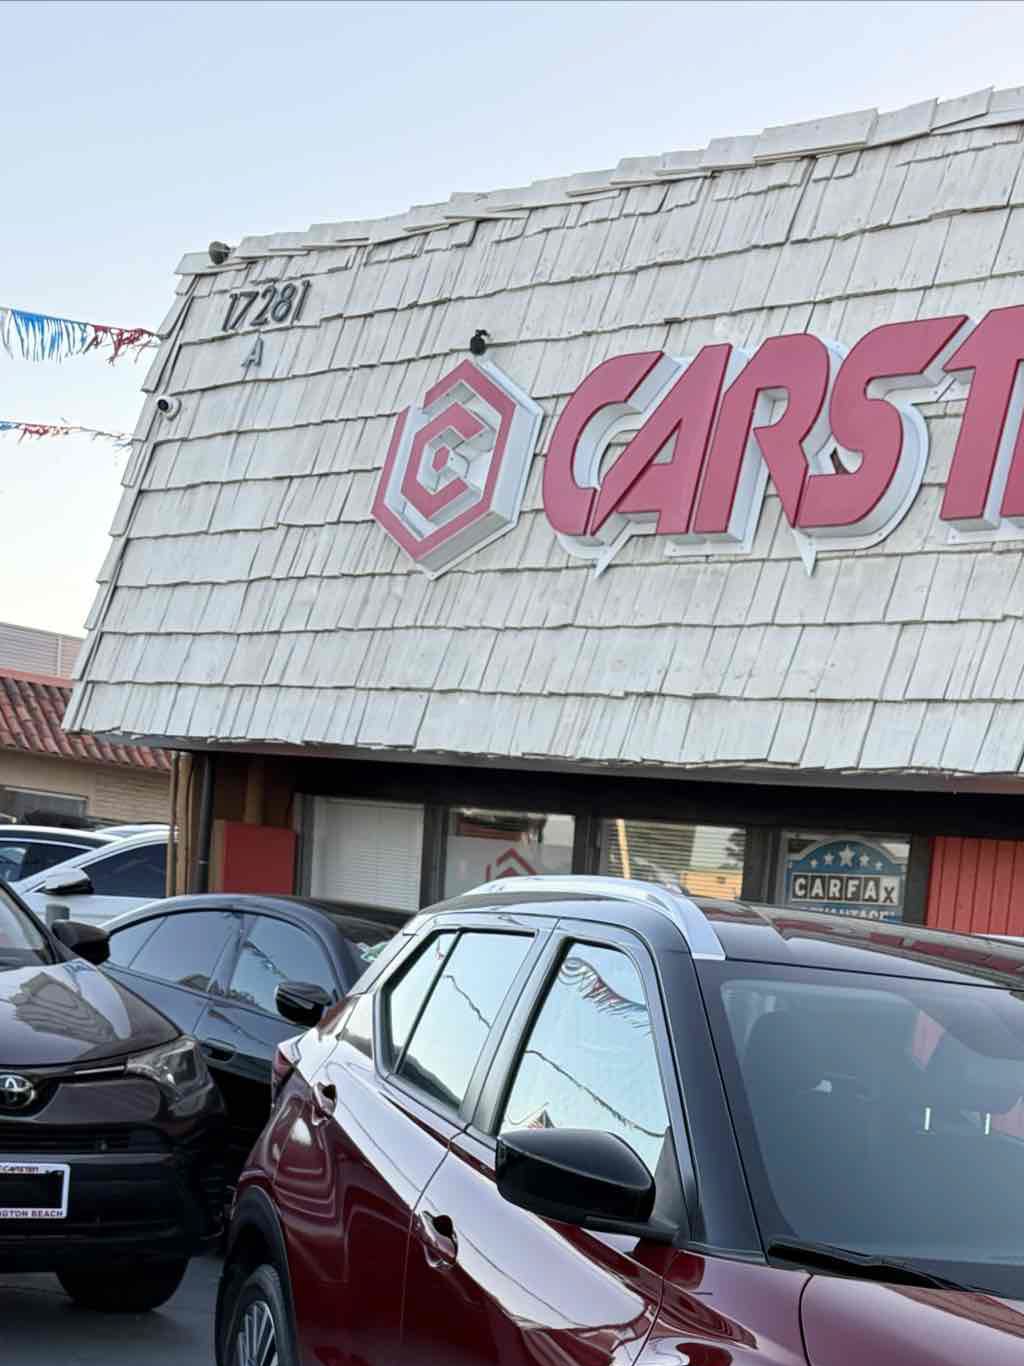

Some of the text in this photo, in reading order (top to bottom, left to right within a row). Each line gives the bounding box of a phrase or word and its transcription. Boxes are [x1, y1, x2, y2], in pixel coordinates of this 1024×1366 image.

[222, 280, 312, 332] 17281
[241, 336, 264, 368] A
[793, 877, 896, 904] CARFAX
